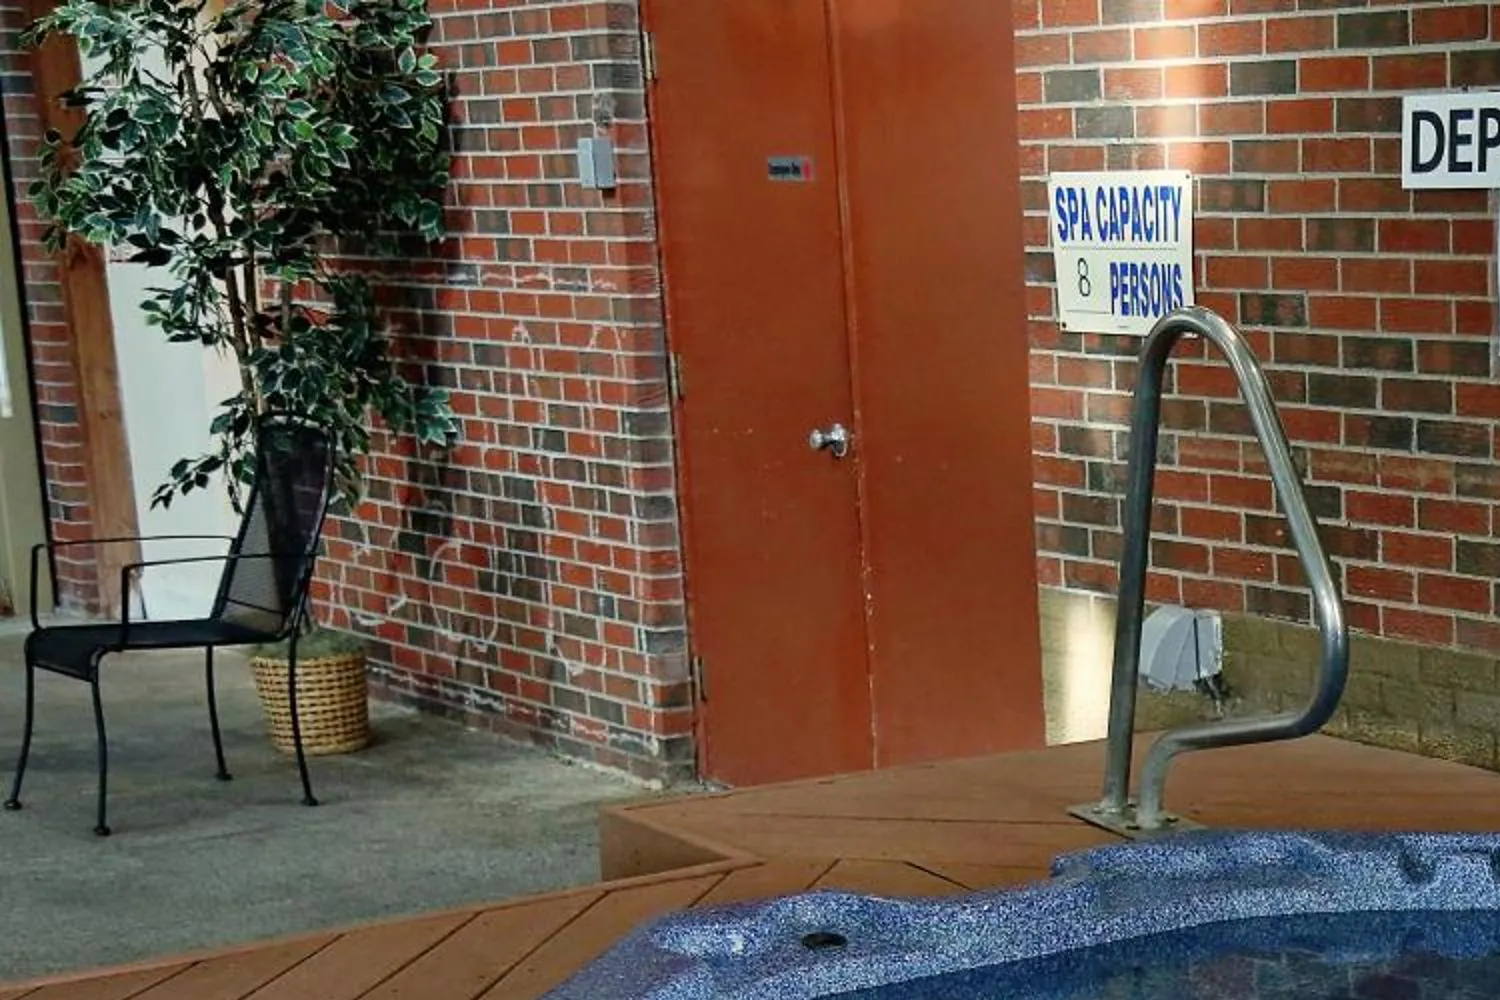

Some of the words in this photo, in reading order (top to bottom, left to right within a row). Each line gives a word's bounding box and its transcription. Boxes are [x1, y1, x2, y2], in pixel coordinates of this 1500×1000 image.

[1055, 186, 1093, 242] SPA
[1095, 185, 1182, 243] CAPACITY
[1077, 257, 1091, 297] 8
[1110, 262, 1184, 318] PERSONS
